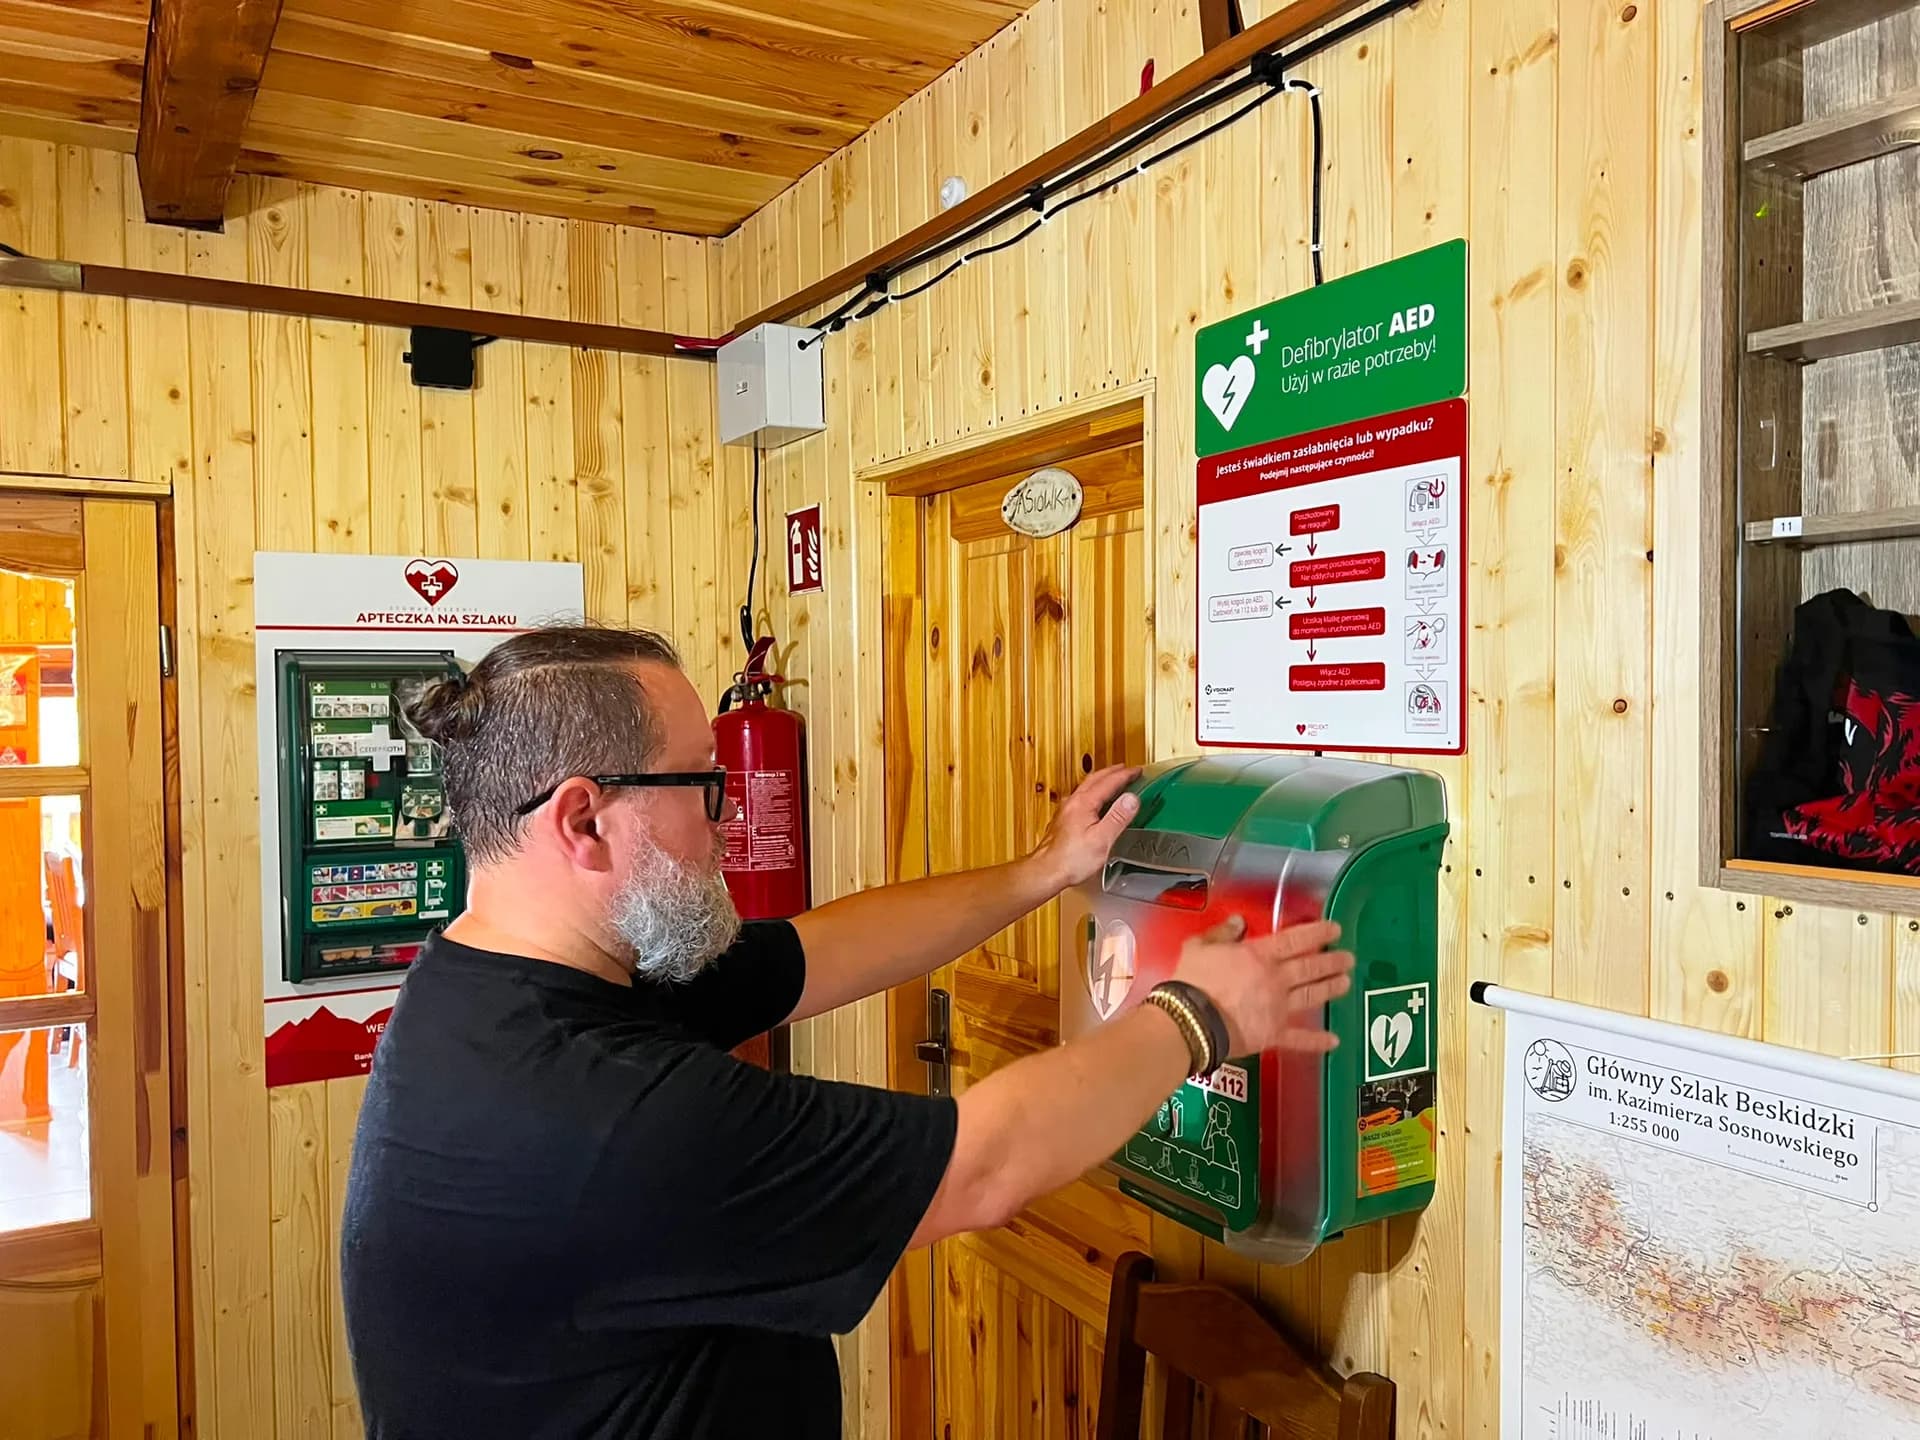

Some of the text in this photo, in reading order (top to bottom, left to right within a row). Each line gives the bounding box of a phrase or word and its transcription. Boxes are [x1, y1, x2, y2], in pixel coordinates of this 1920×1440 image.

[1281, 303, 1435, 369] Defibrylator AED
[1281, 335, 1436, 394] Użyj w razie potrzeby!
[1216, 417, 1434, 478] Jesteś świadkiem zasłabnięcia lub wypadku?
[1259, 449, 1374, 481] Podejmij następujące czynności!
[1781, 521, 1793, 532] 11
[356, 612, 517, 626] APTECZKA NA SZLAKU
[1221, 1075, 1244, 1098] 112
[1587, 1055, 1856, 1140] Główny Szlak Beskidzki
[1588, 1082, 1612, 1102] im.
[1617, 1089, 1714, 1129] Kazimierza
[1718, 1115, 1859, 1169] Sosnowskiego
[1608, 1111, 1680, 1143] 1:255 000
